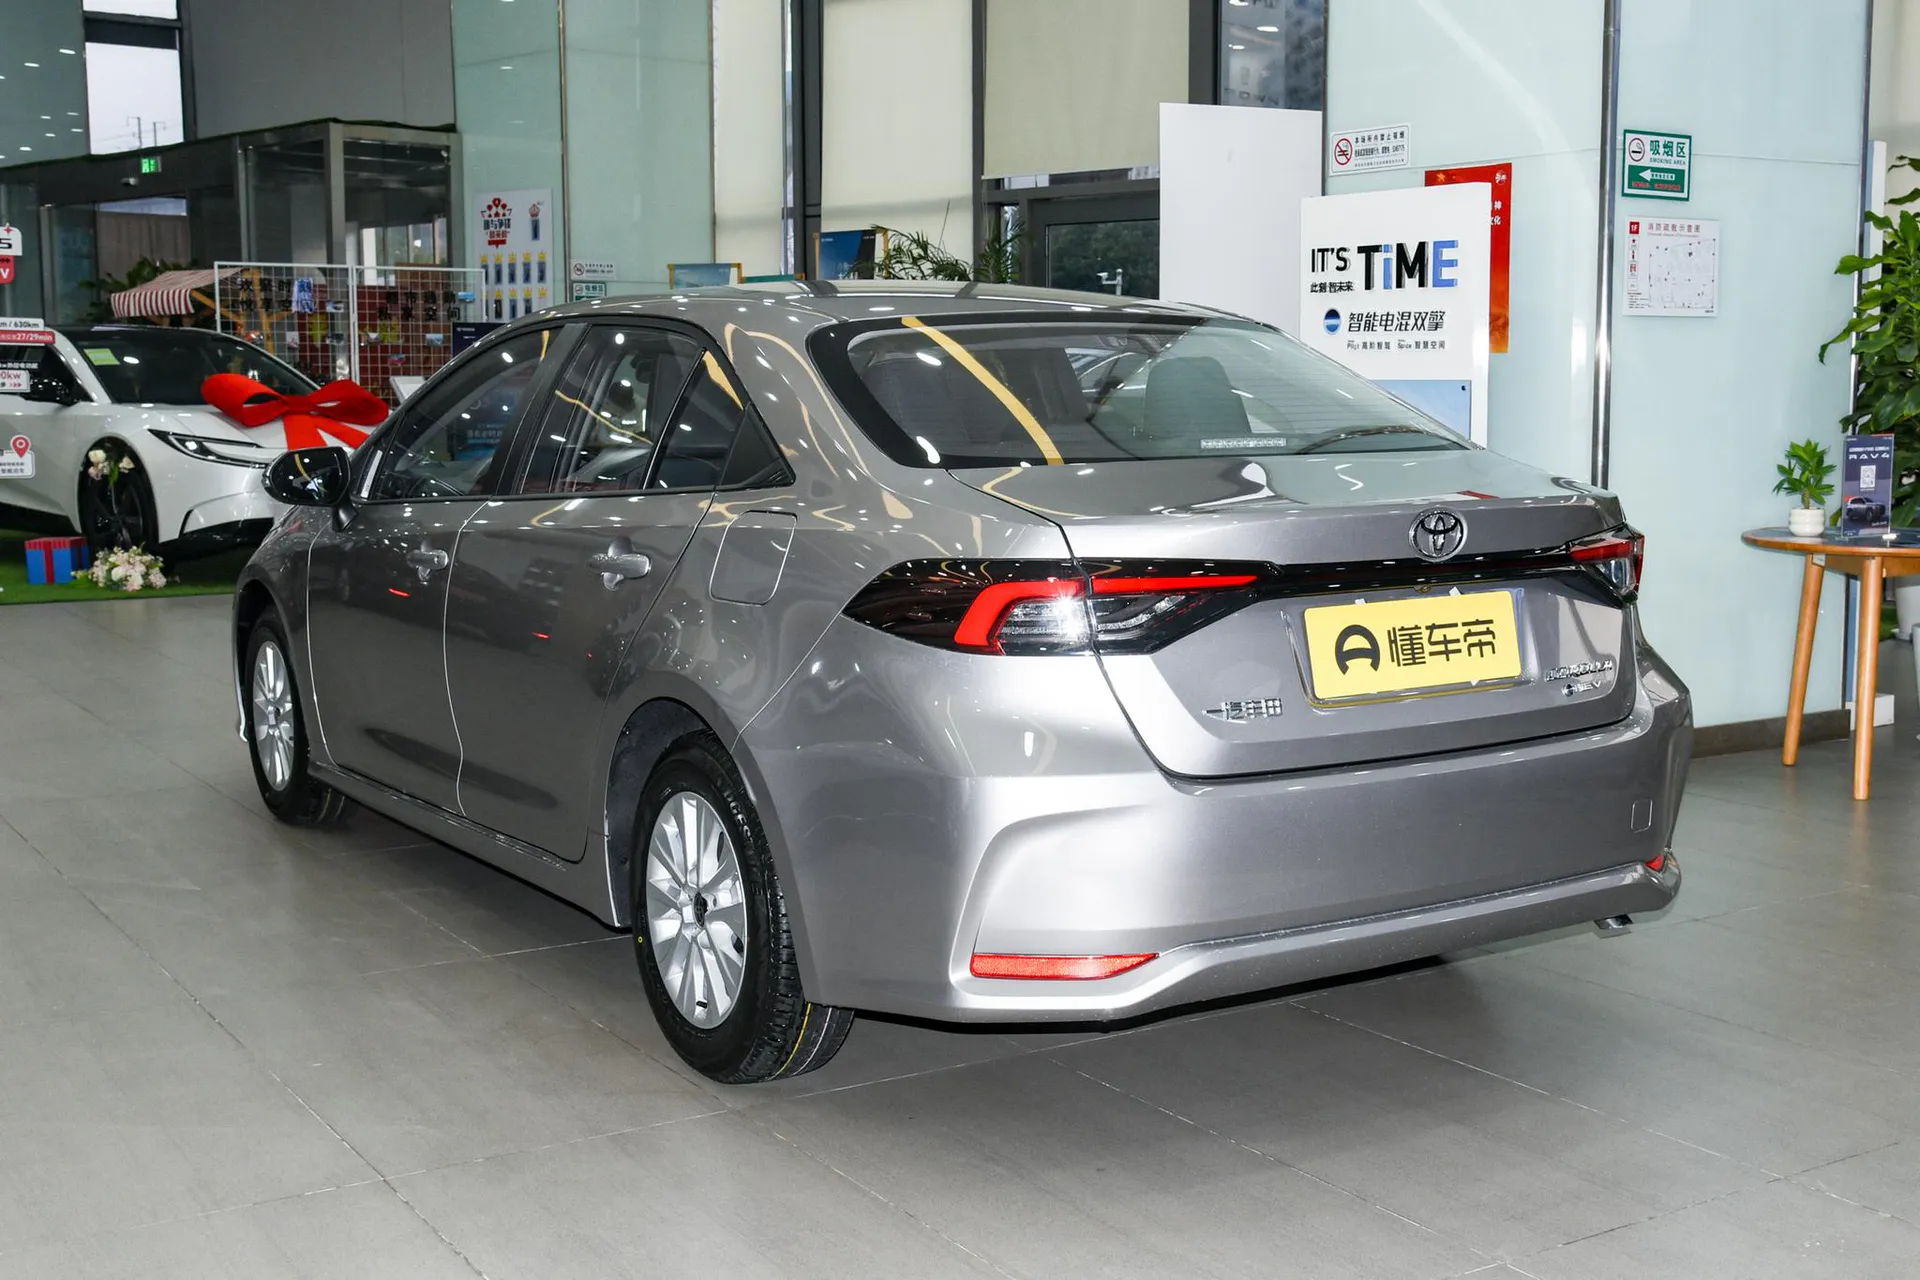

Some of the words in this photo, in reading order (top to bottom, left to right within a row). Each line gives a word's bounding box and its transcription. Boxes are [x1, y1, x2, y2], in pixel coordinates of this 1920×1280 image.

[1650, 140, 1686, 158] 吸烟区
[1348, 310, 1445, 332] 智能电混双擎
[1849, 452, 1890, 460] RAV4
[1387, 618, 1497, 667] 懂车帝
[1202, 698, 1283, 724] 一汽丰田
